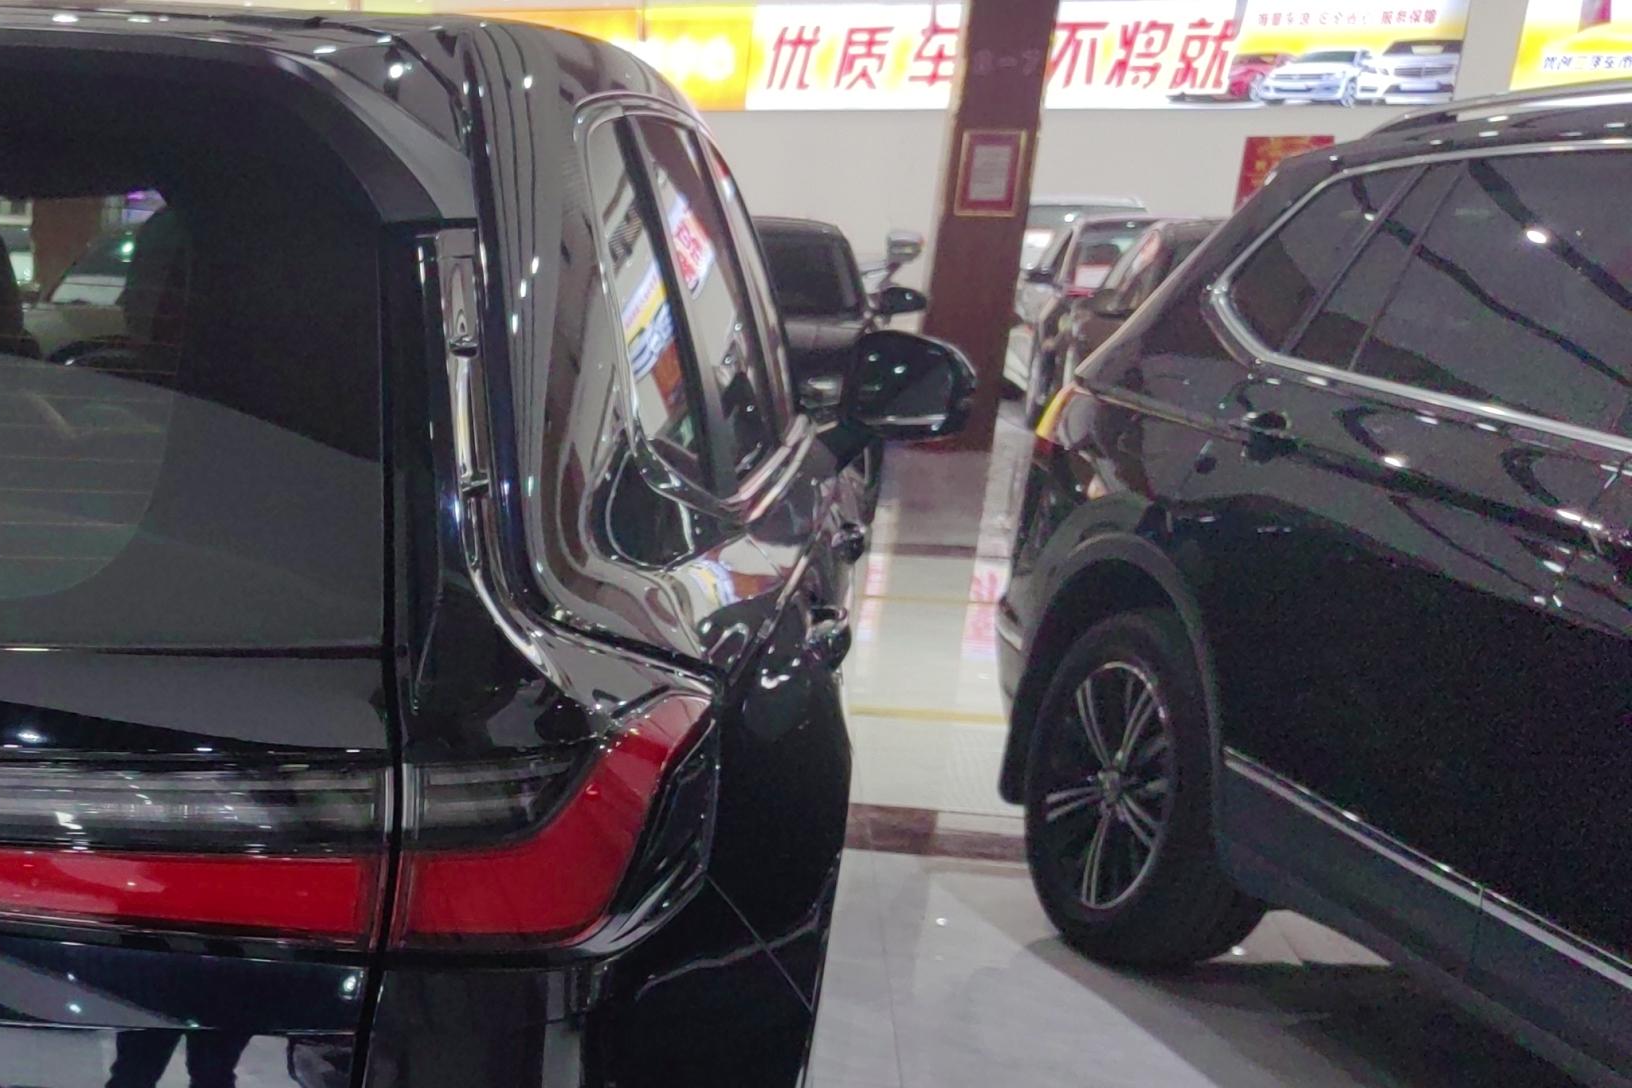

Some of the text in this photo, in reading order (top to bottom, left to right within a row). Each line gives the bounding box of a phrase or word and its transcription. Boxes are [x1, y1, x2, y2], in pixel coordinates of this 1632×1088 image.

[767, 20, 961, 90] 优质车
[1047, 18, 1237, 90] 不将就
